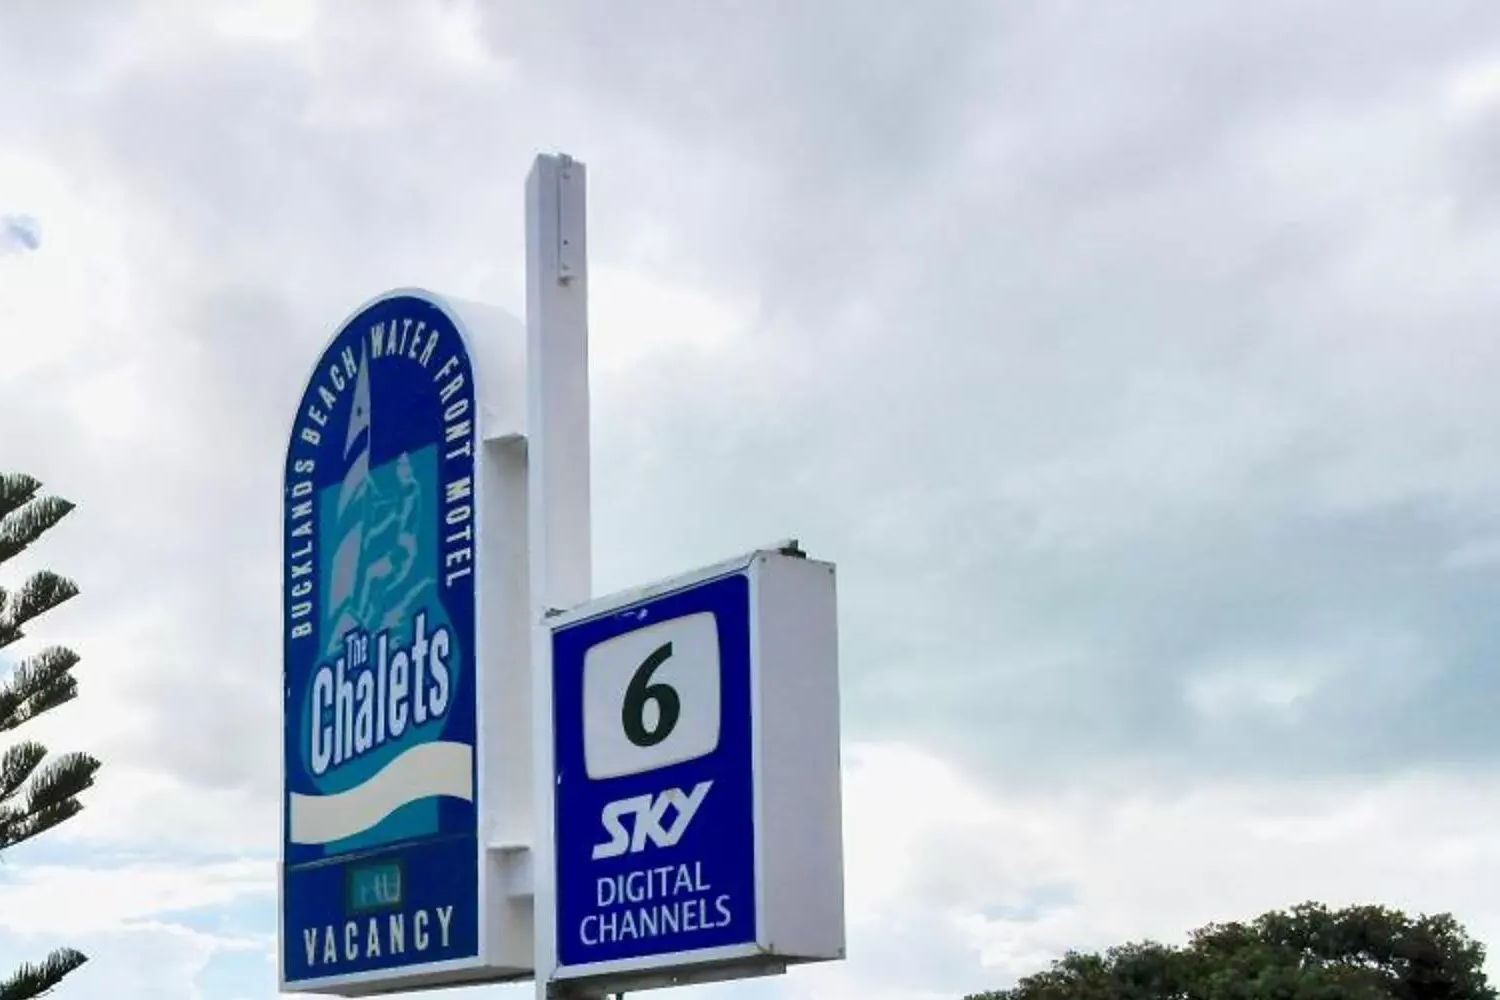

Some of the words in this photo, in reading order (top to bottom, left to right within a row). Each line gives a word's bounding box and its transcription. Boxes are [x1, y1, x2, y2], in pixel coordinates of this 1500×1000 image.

[370, 318, 440, 369] WATER
[301, 346, 358, 446] BEACH
[433, 354, 472, 461] FRONT
[291, 459, 315, 639] BUCKLANDS
[444, 475, 474, 587] MOTEL
[311, 612, 451, 776] Chalets
[345, 632, 369, 670] The
[621, 640, 681, 748] 6
[591, 780, 714, 861] SKY
[579, 894, 732, 946] CHANNELS
[596, 861, 711, 908] DIGITAL
[302, 905, 454, 967] VACANCY
